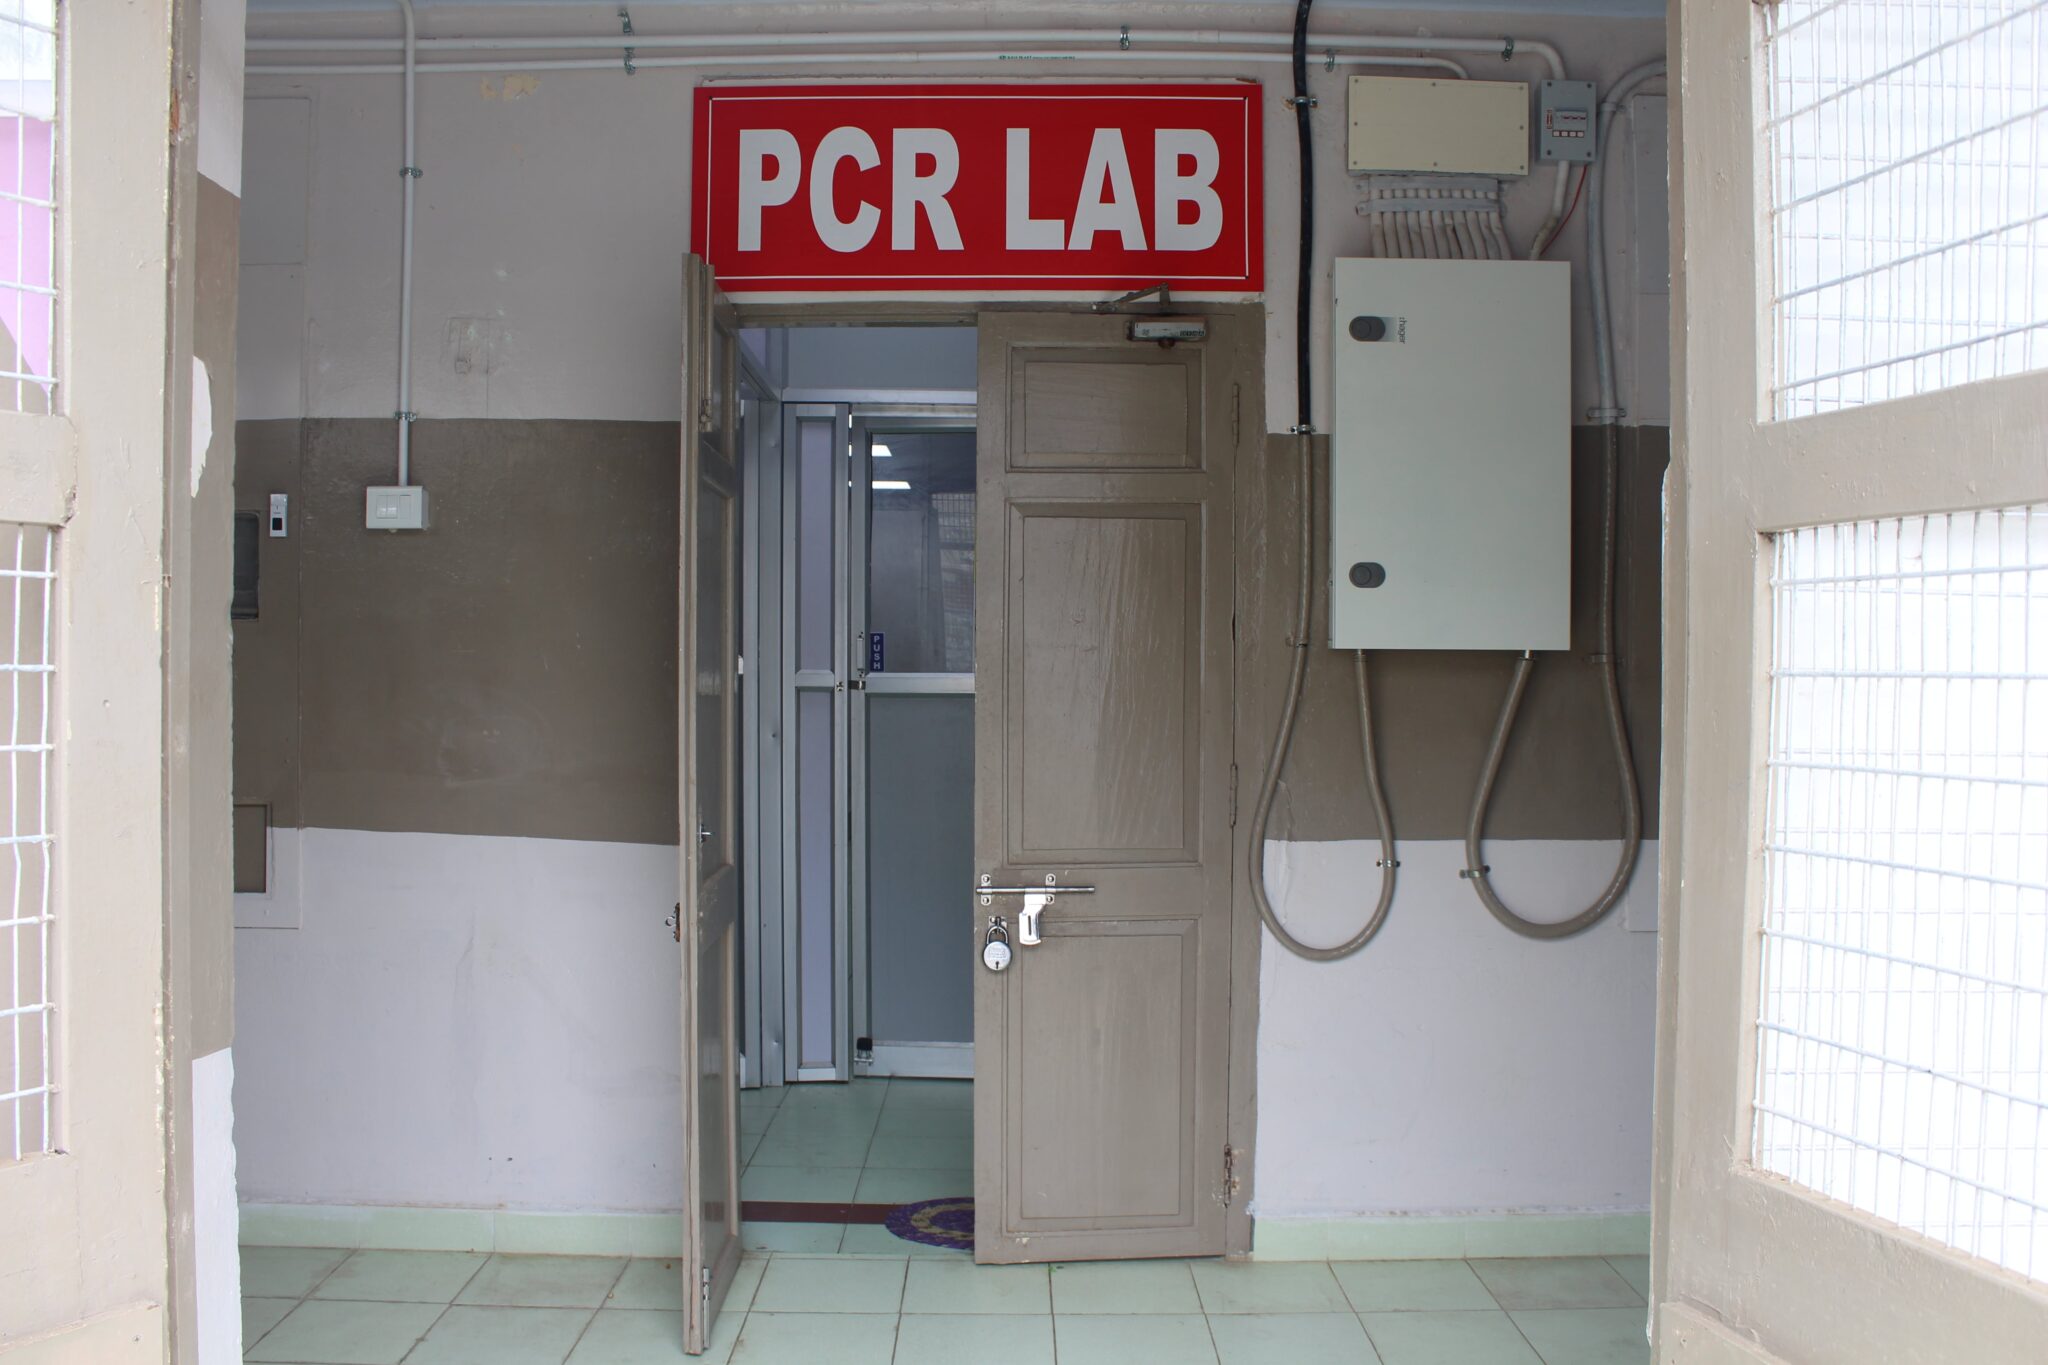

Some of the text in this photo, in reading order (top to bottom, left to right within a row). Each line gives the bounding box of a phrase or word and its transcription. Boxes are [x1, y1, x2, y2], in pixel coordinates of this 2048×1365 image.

[737, 126, 1223, 253] PCR LAB
[873, 635, 881, 670] PUSH
